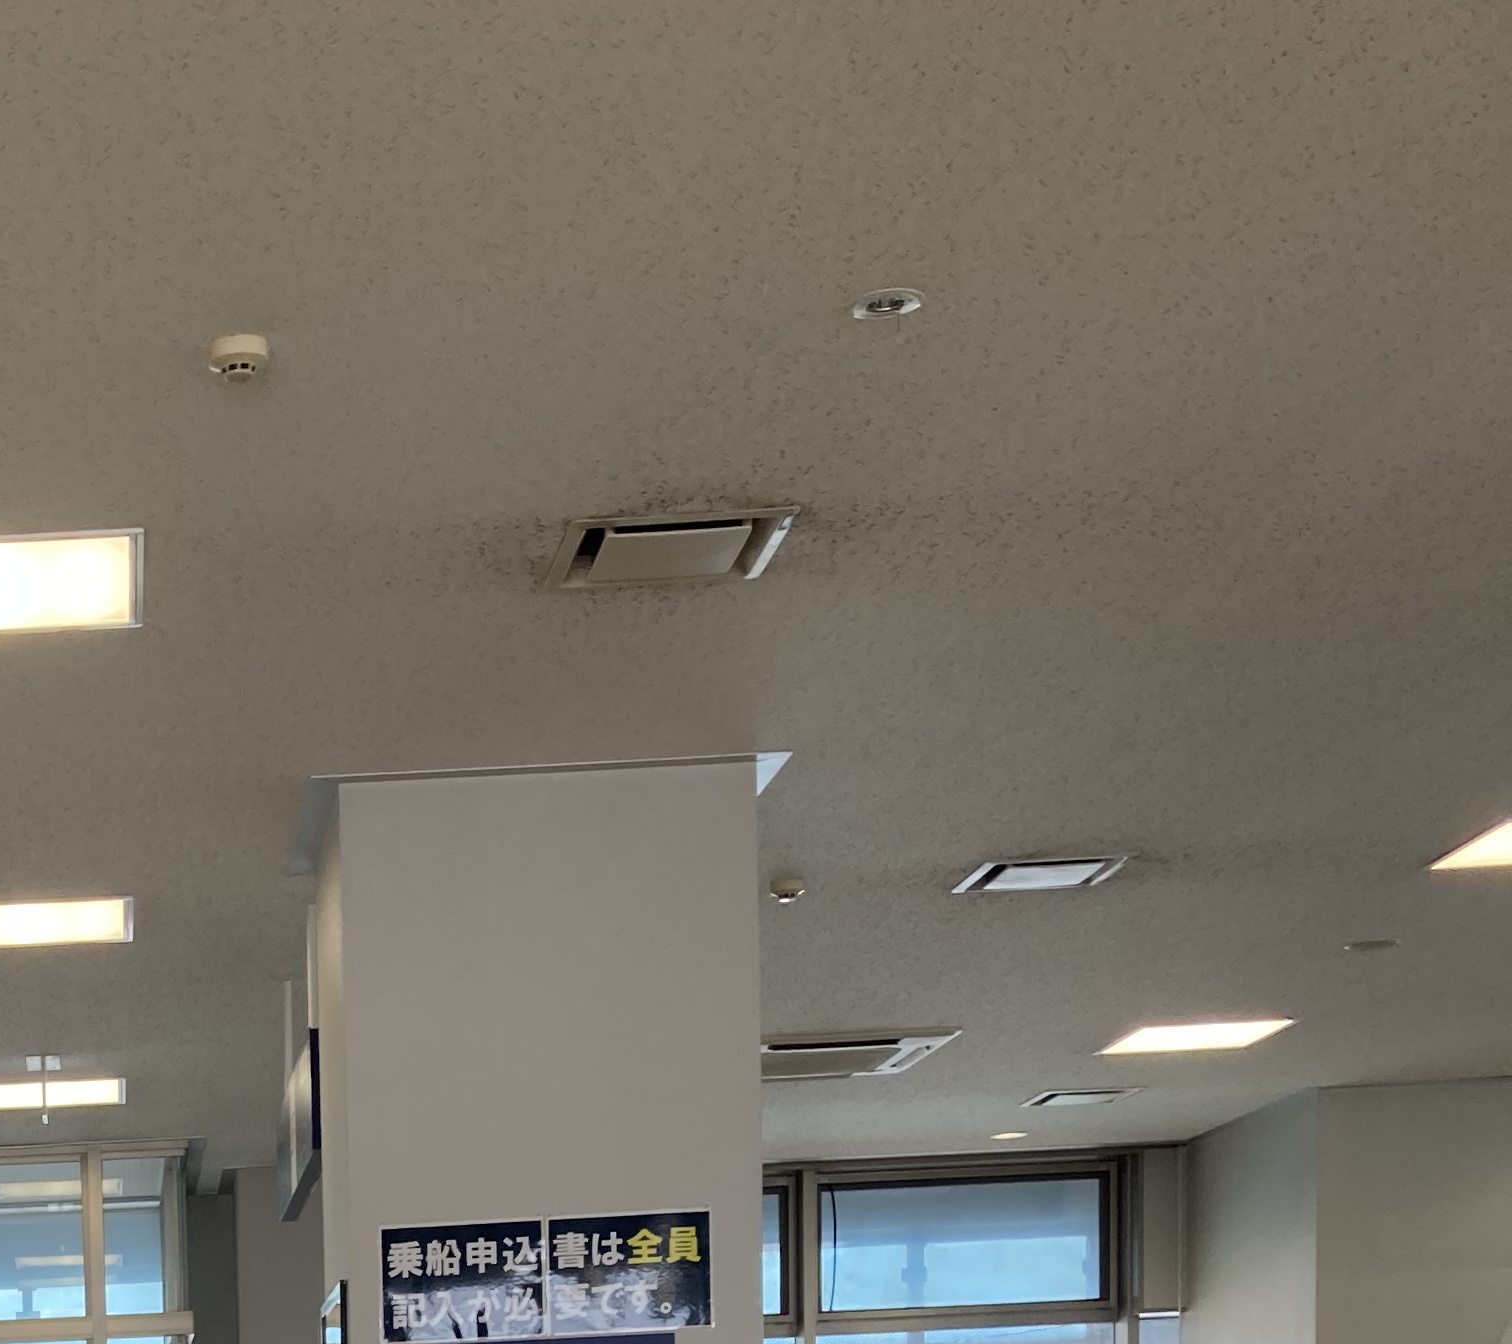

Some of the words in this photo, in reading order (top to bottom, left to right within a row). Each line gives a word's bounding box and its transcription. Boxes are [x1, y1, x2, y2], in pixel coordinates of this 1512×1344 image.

[386, 1225, 703, 1280] 乗船申込書は全員
[391, 1278, 675, 1330] 記入が必要です。
